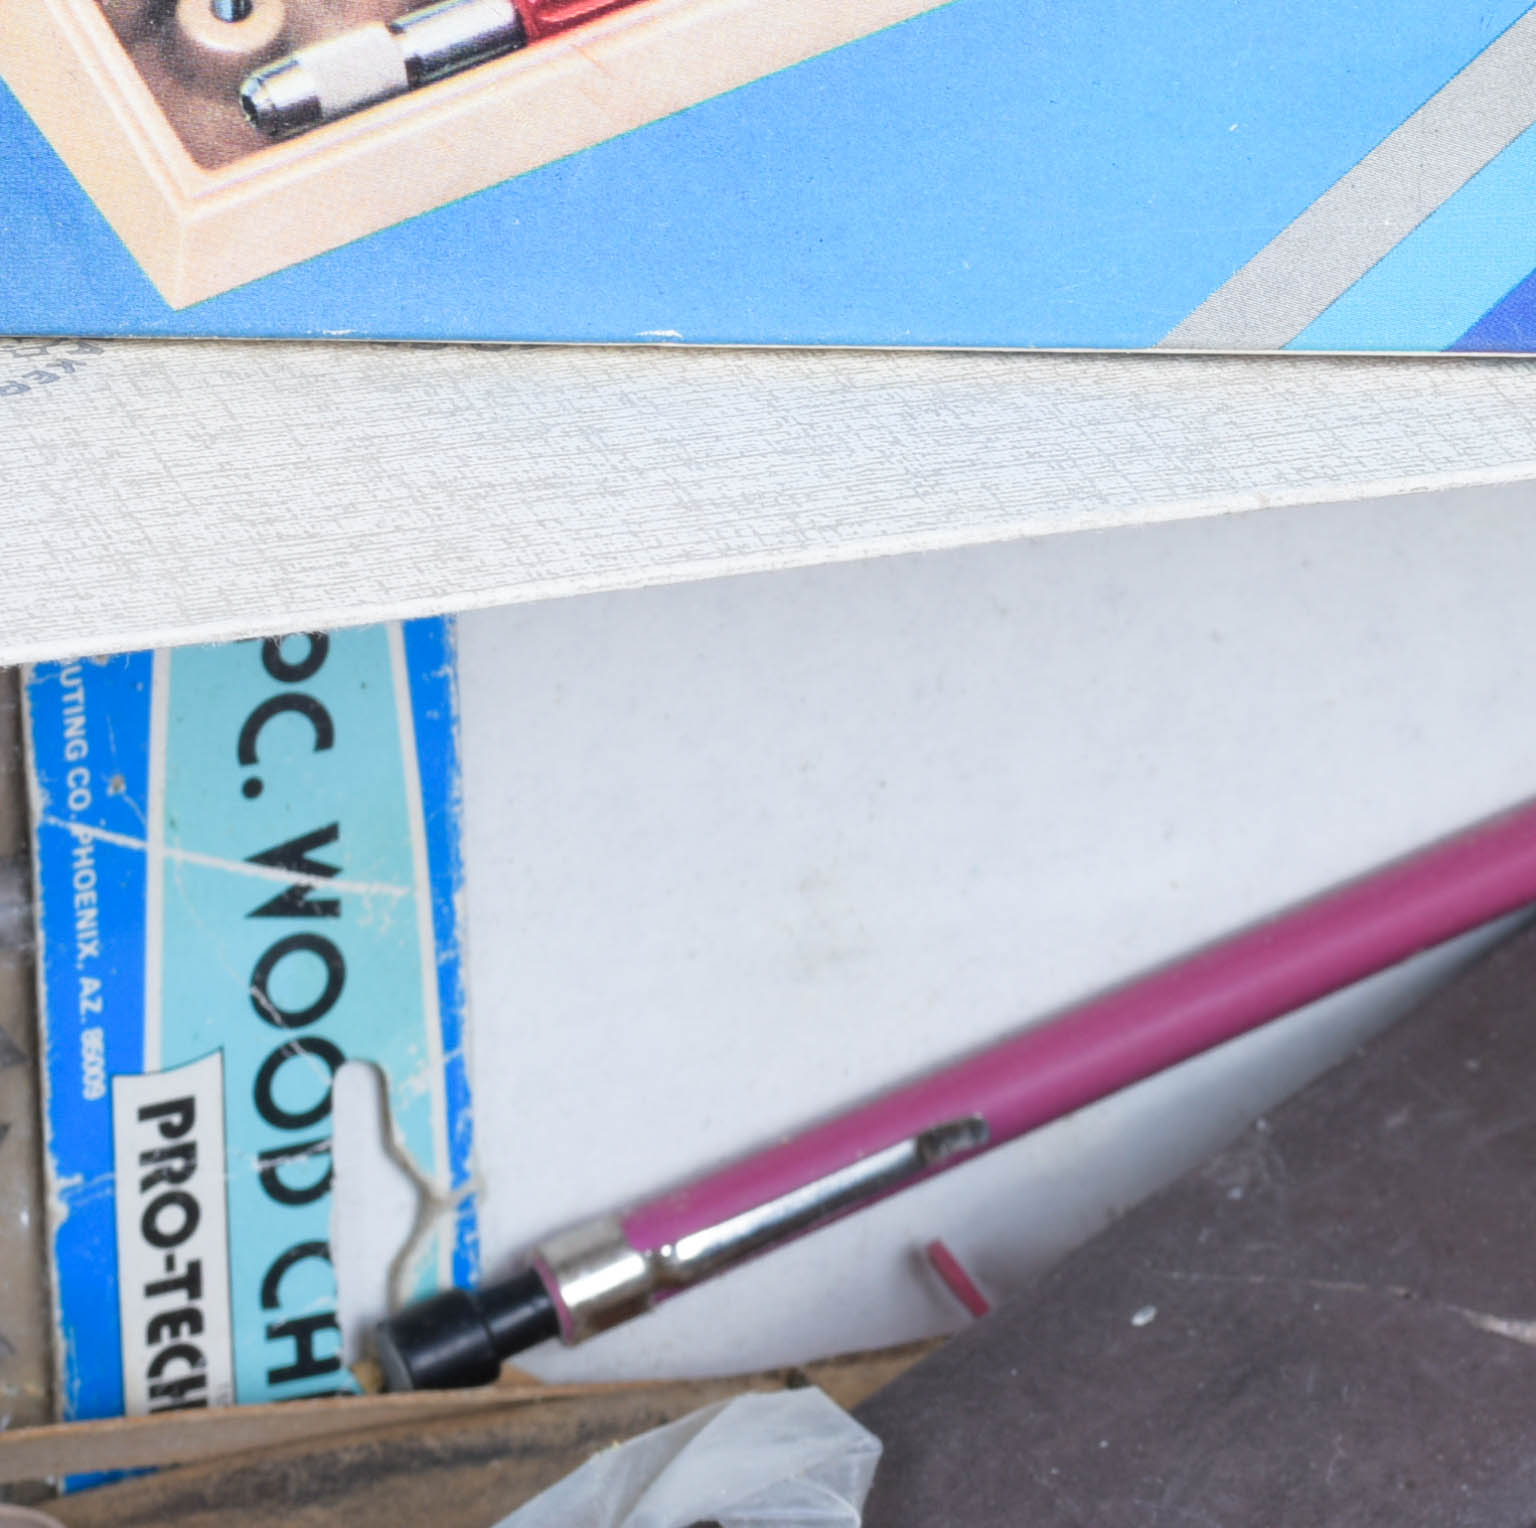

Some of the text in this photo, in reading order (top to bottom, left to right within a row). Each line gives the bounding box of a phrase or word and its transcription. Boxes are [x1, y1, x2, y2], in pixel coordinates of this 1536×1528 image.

[59, 658, 89, 761] UTING
[66, 765, 92, 820] CO.
[78, 976, 104, 1024] AZ.
[242, 820, 348, 1210] WOOD
[135, 1094, 208, 1414] PRO-TECH
[260, 1239, 360, 1403] CH
